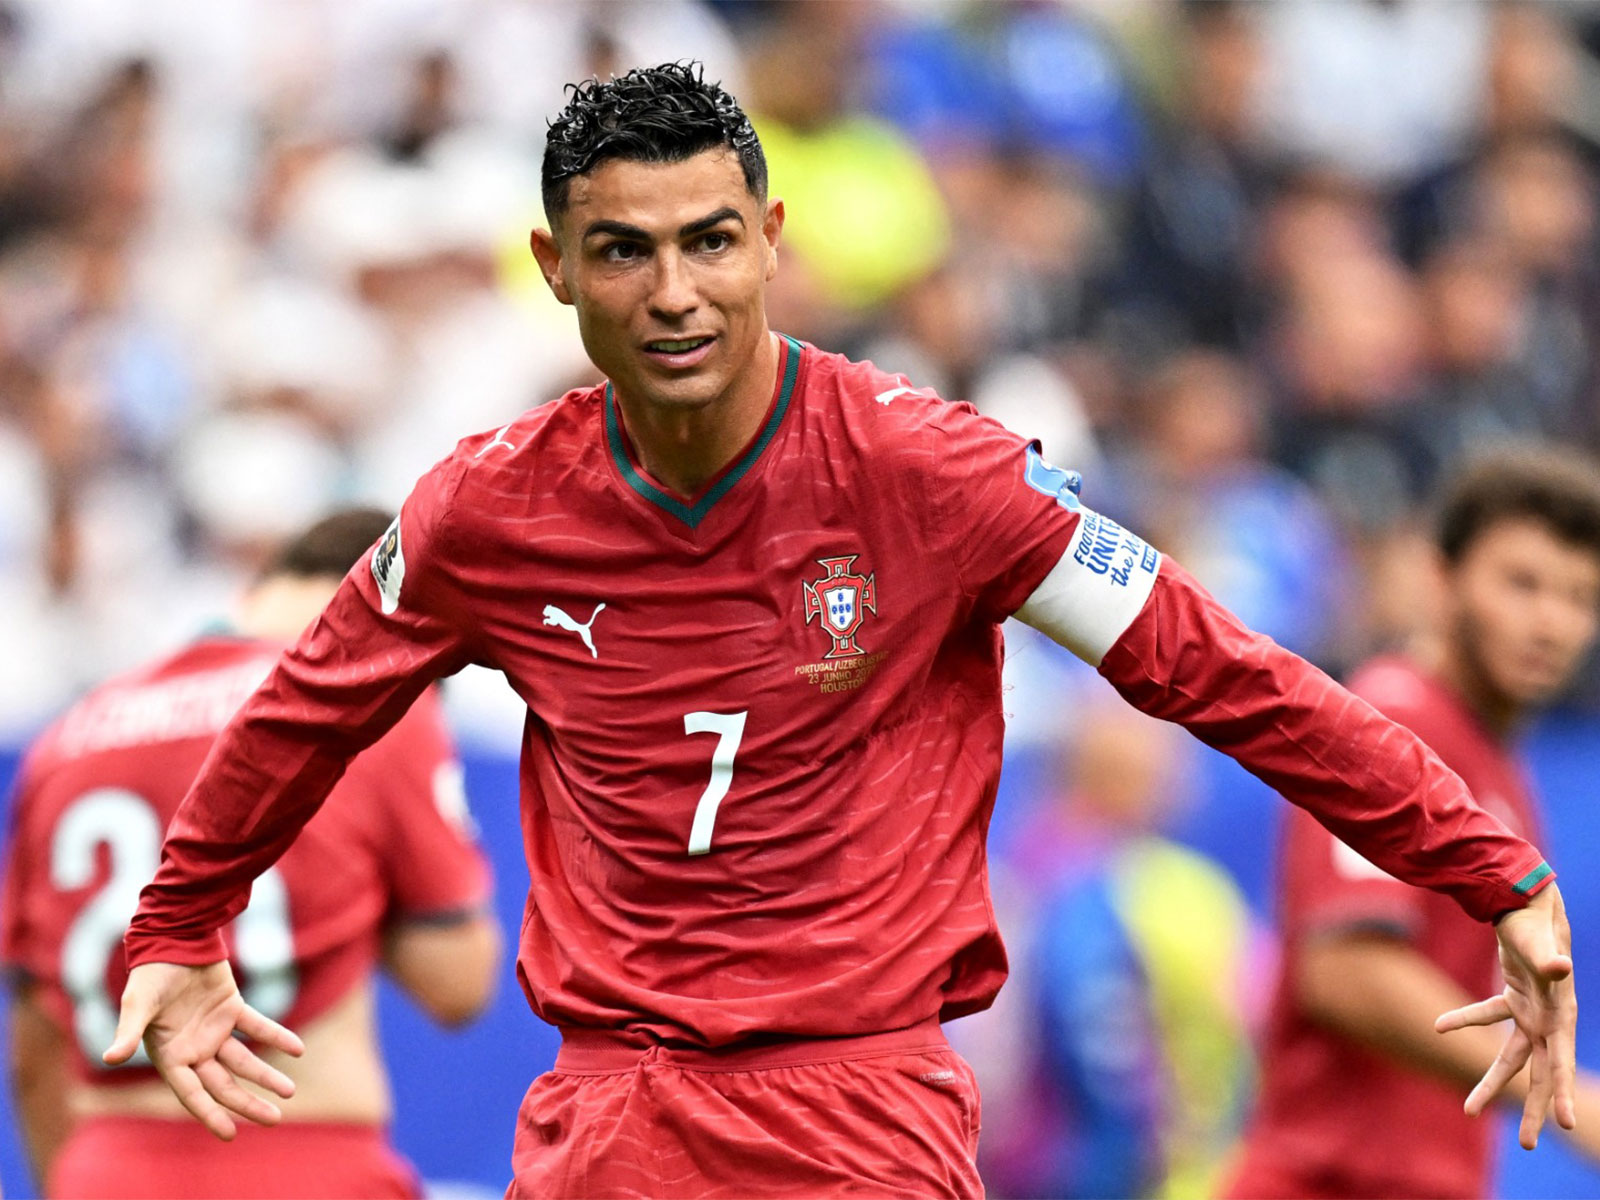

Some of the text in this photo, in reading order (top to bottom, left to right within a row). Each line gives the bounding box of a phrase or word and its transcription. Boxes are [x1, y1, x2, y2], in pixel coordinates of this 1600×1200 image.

[1110, 556, 1134, 587] the
[808, 673, 820, 685] 23
[822, 671, 851, 683] JUNHO
[683, 710, 748, 856] 7
